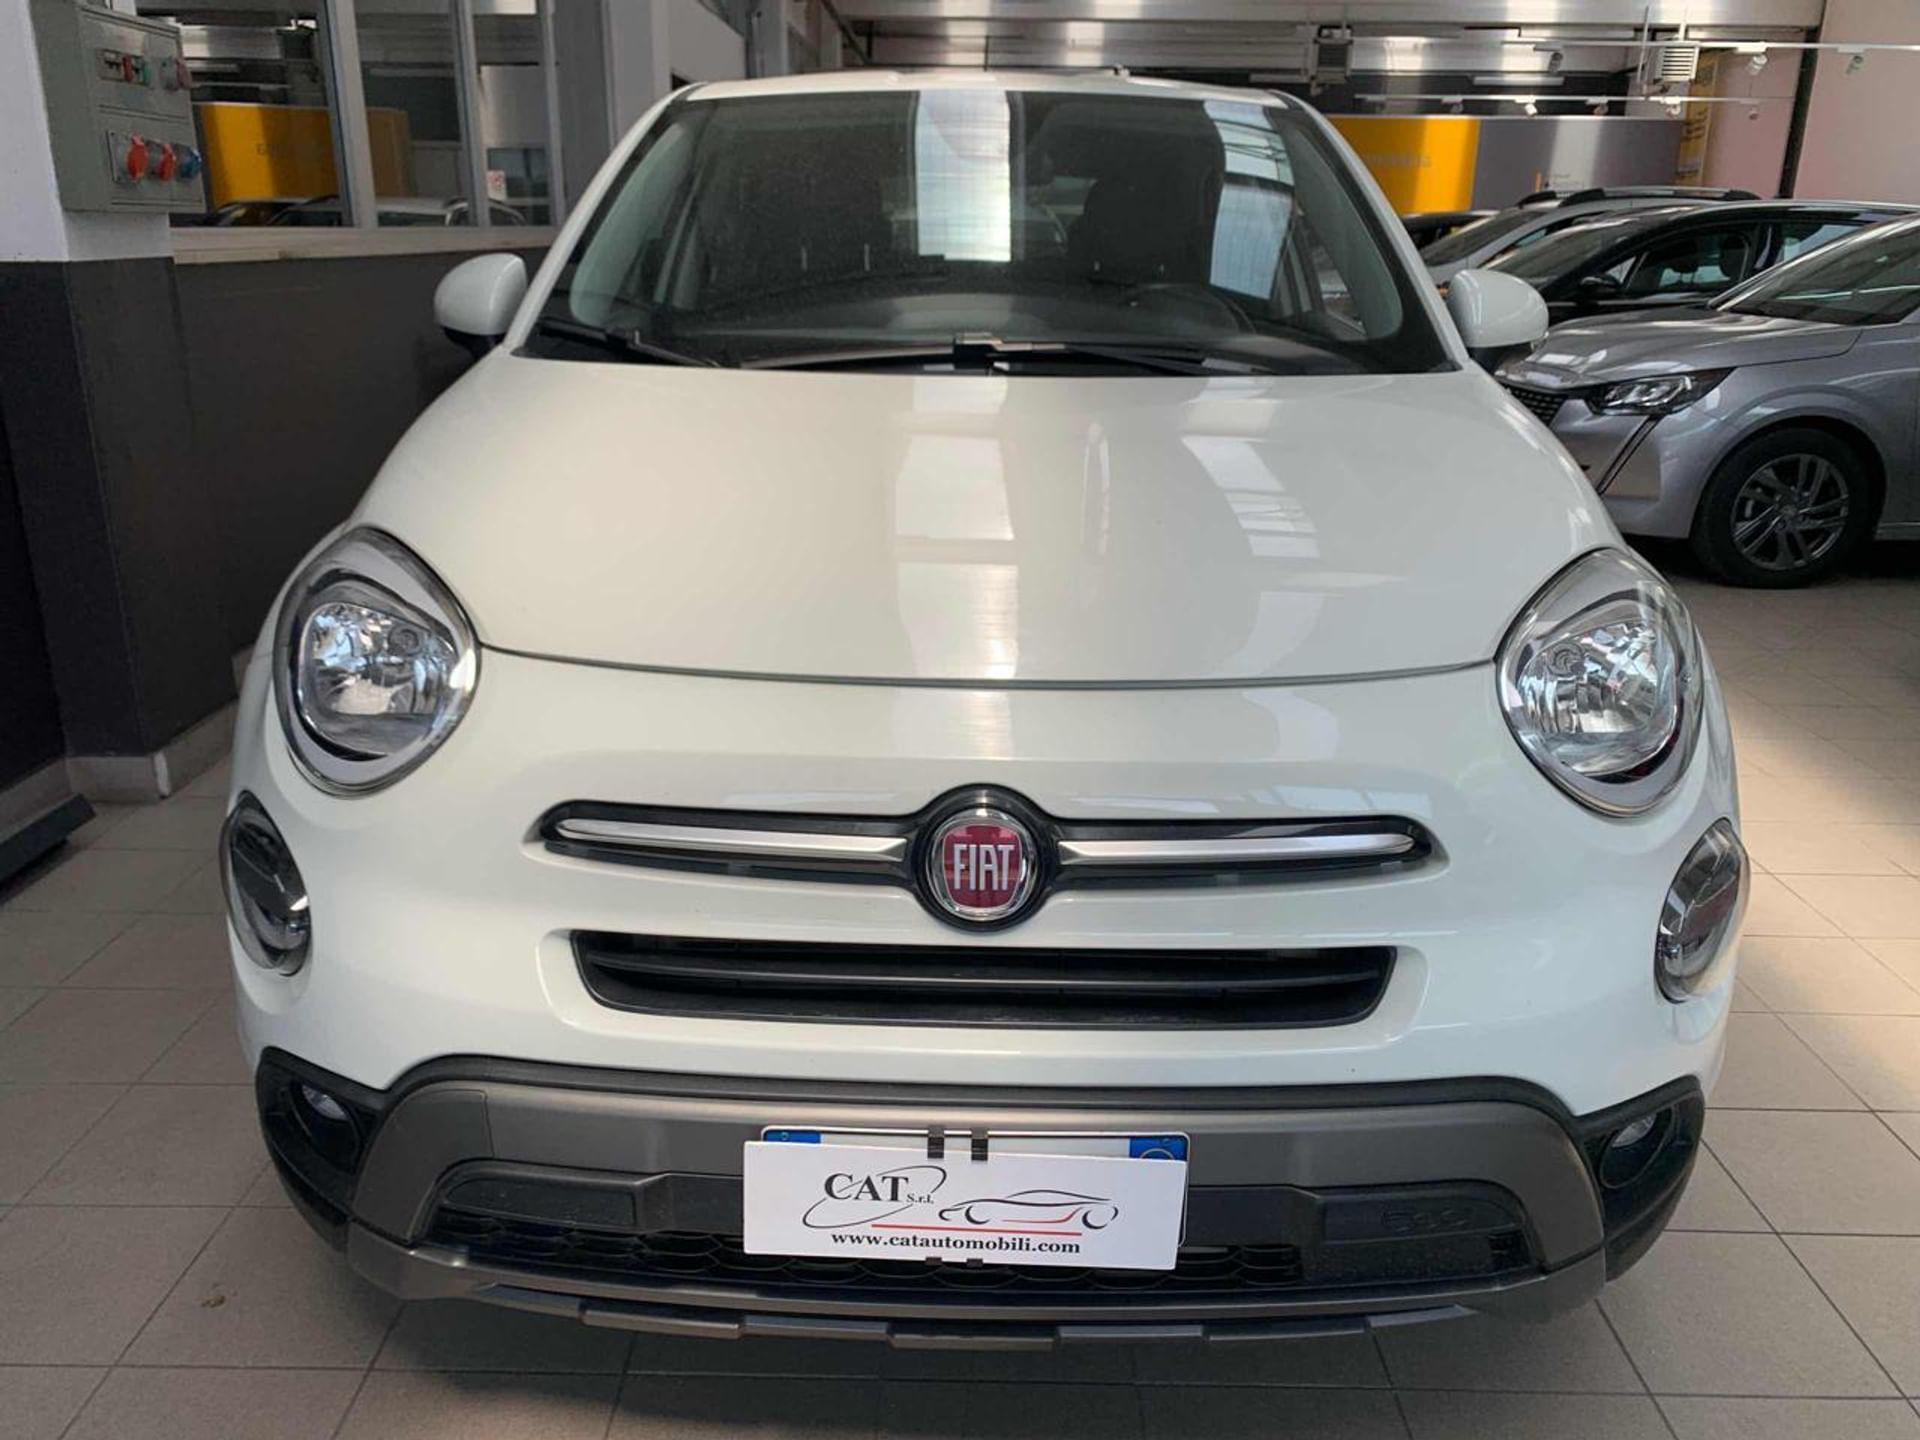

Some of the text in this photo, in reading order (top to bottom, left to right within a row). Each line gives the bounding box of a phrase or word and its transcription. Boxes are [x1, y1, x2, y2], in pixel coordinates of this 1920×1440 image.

[953, 843, 1015, 891] FIAT
[824, 1173, 909, 1202] CAT
[831, 1233, 1080, 1254] www.catautomobili.com
